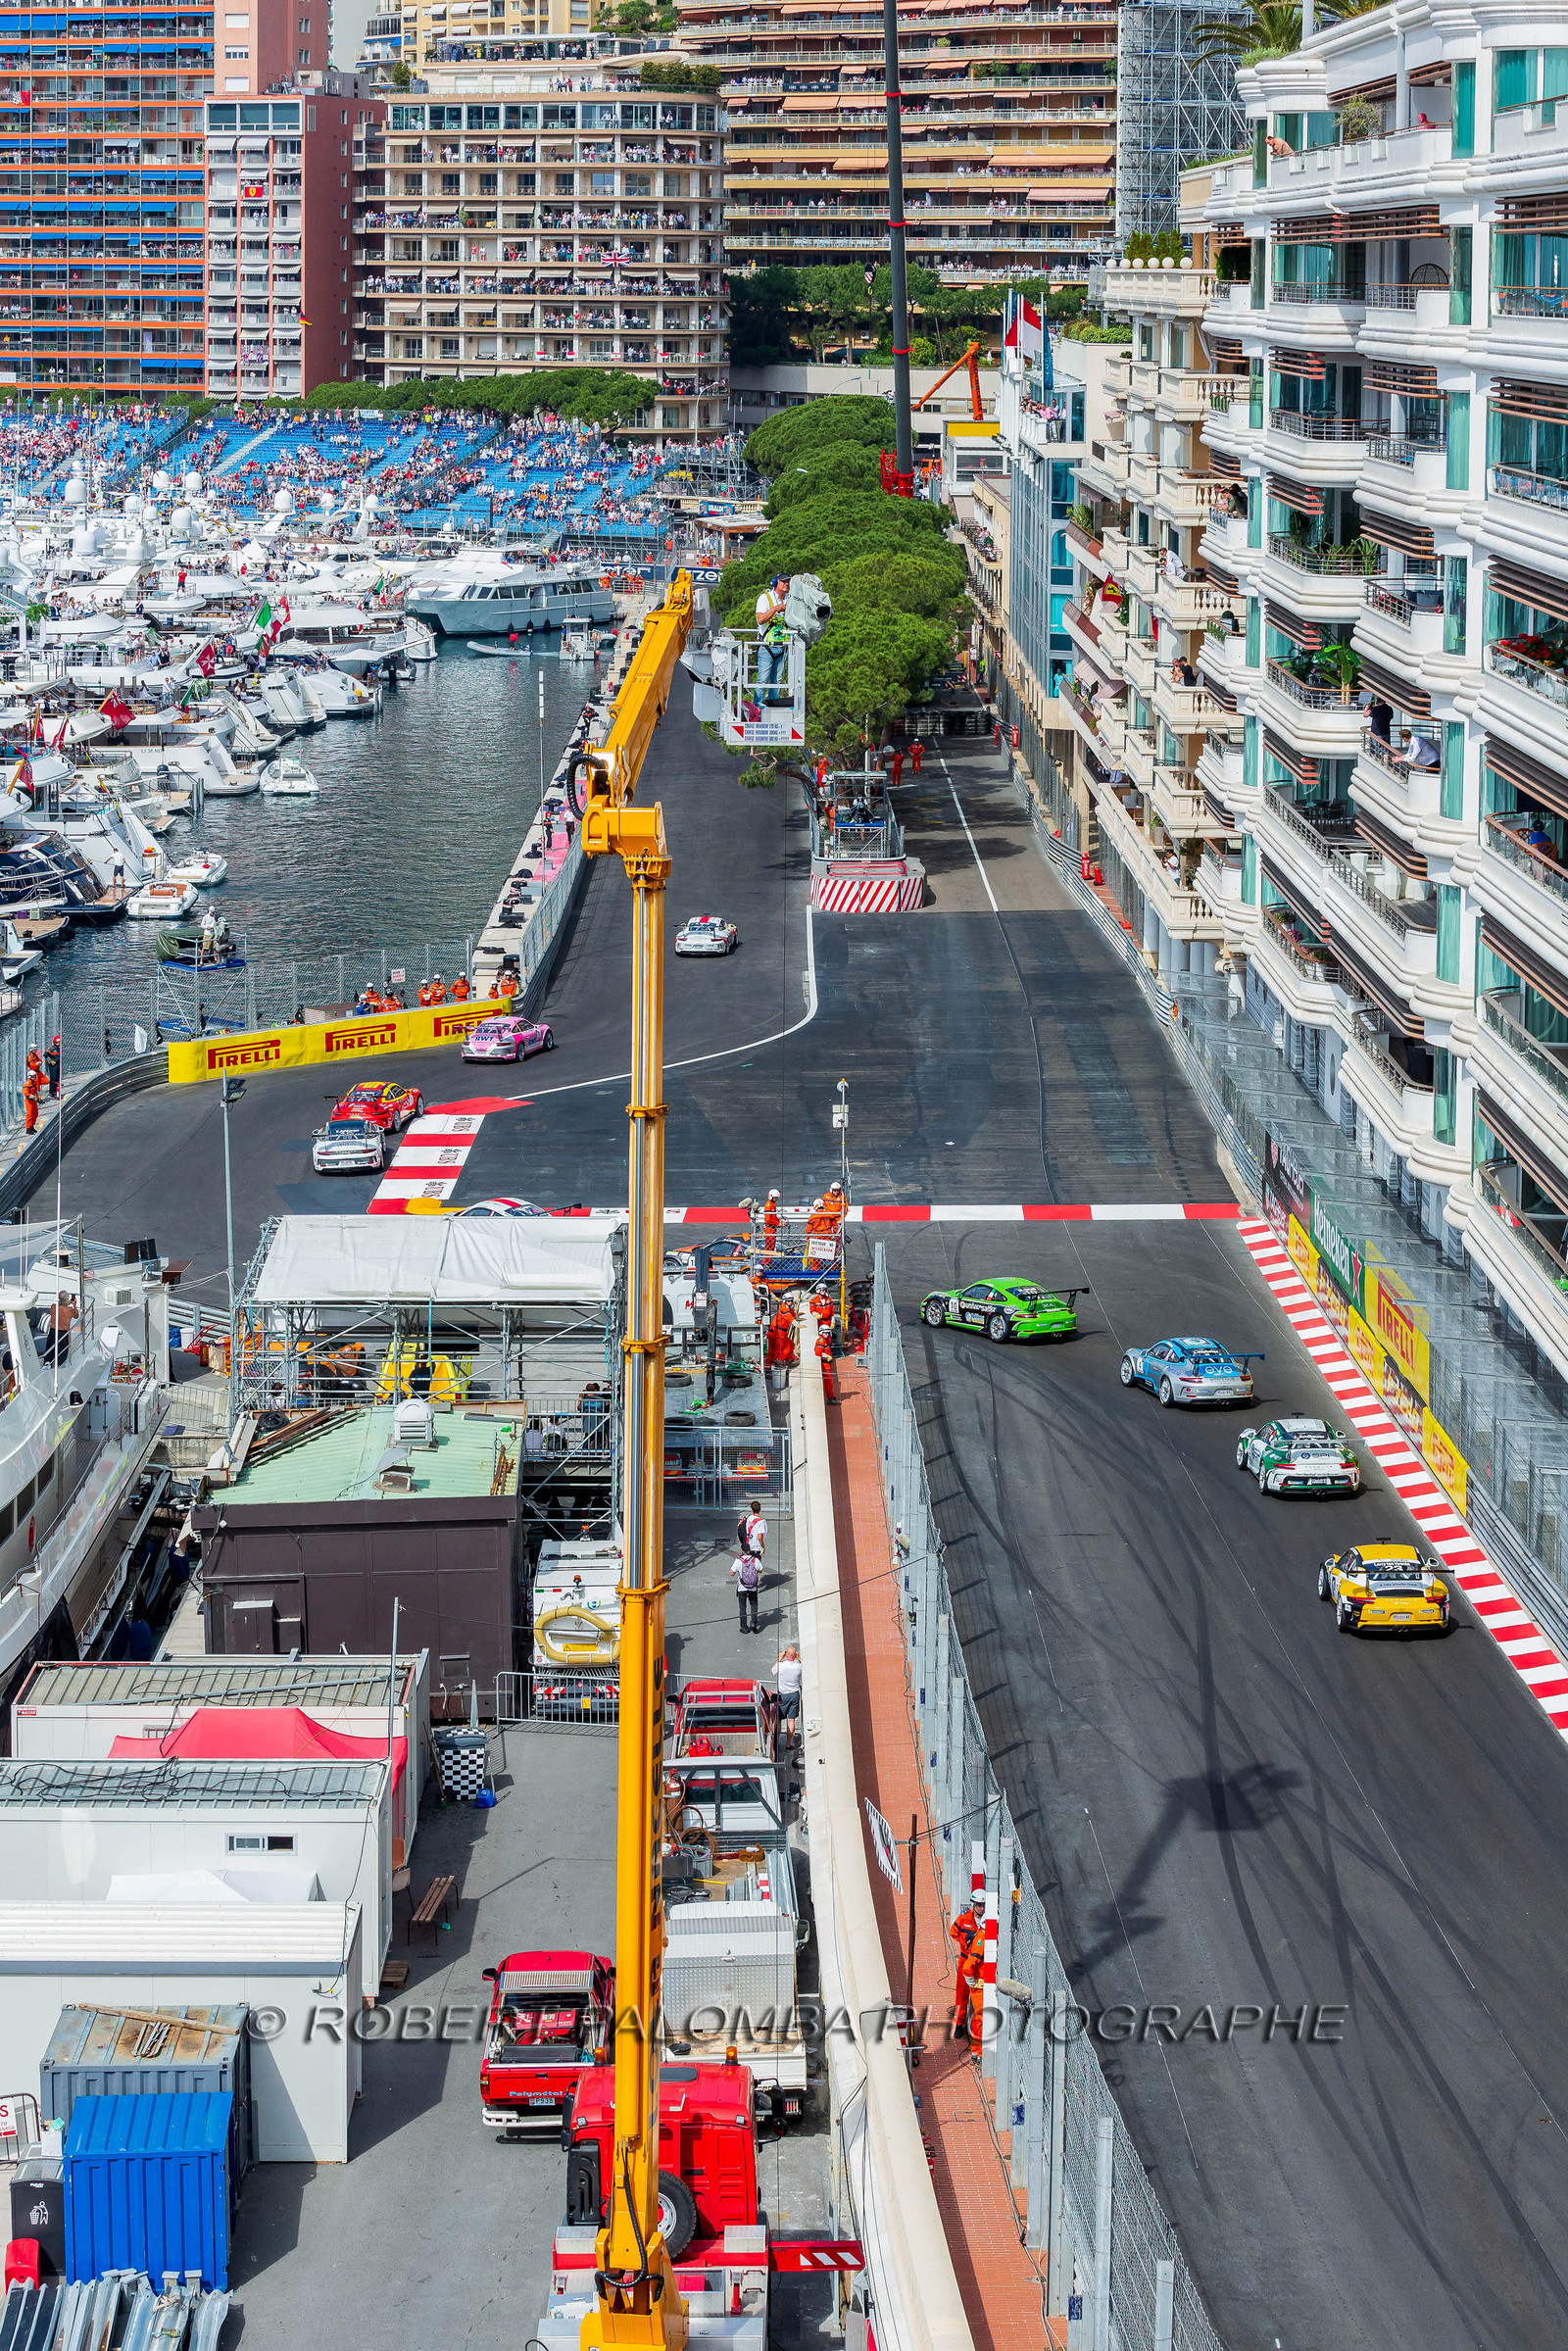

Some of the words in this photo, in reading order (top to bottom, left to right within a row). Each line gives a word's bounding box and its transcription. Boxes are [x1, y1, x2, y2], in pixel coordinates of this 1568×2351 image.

[208, 1039, 281, 1069] PIRELLI
[326, 1022, 397, 1053] PIRELLI
[1314, 1193, 1351, 1286] Heineken
[950, 1301, 957, 1310] 10
[1377, 1268, 1415, 1371] PIRELLI
[650, 1654, 663, 1932] NACELLE
